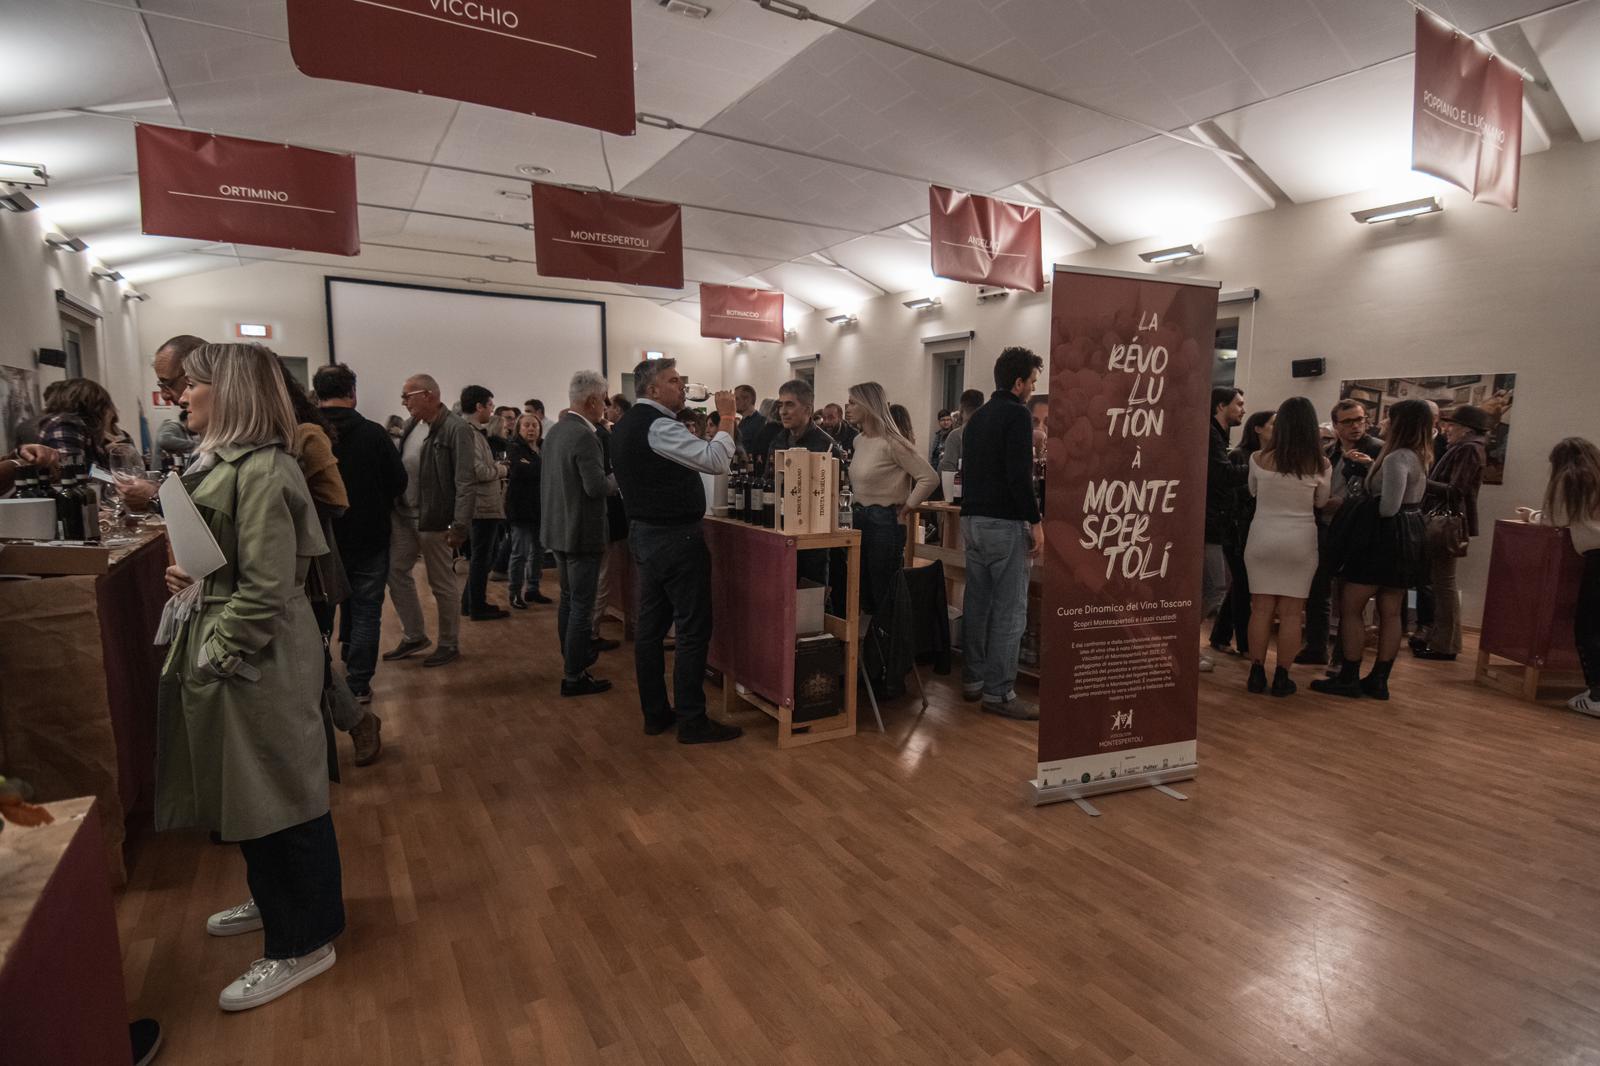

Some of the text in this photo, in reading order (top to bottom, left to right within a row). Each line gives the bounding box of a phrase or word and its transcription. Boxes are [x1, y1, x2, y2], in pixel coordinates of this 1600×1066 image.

[430, 0, 518, 28] VICCHIO
[1423, 90, 1460, 120] POPPIANO
[1460, 110, 1466, 124] E
[218, 184, 288, 202] ORTIMINO
[570, 230, 649, 248] MONTESPERTOLI
[1138, 310, 1158, 331] LA
[1108, 336, 1168, 374] RÉVO
[1128, 374, 1164, 405] LU
[1083, 478, 1180, 514] MONTE
[1080, 514, 1150, 550] SPER
[1057, 599, 1192, 616] Cuore Dinamico del Vino Toscano
[1073, 620, 1092, 629] Scopri
[1094, 616, 1135, 626] Montespertoli
